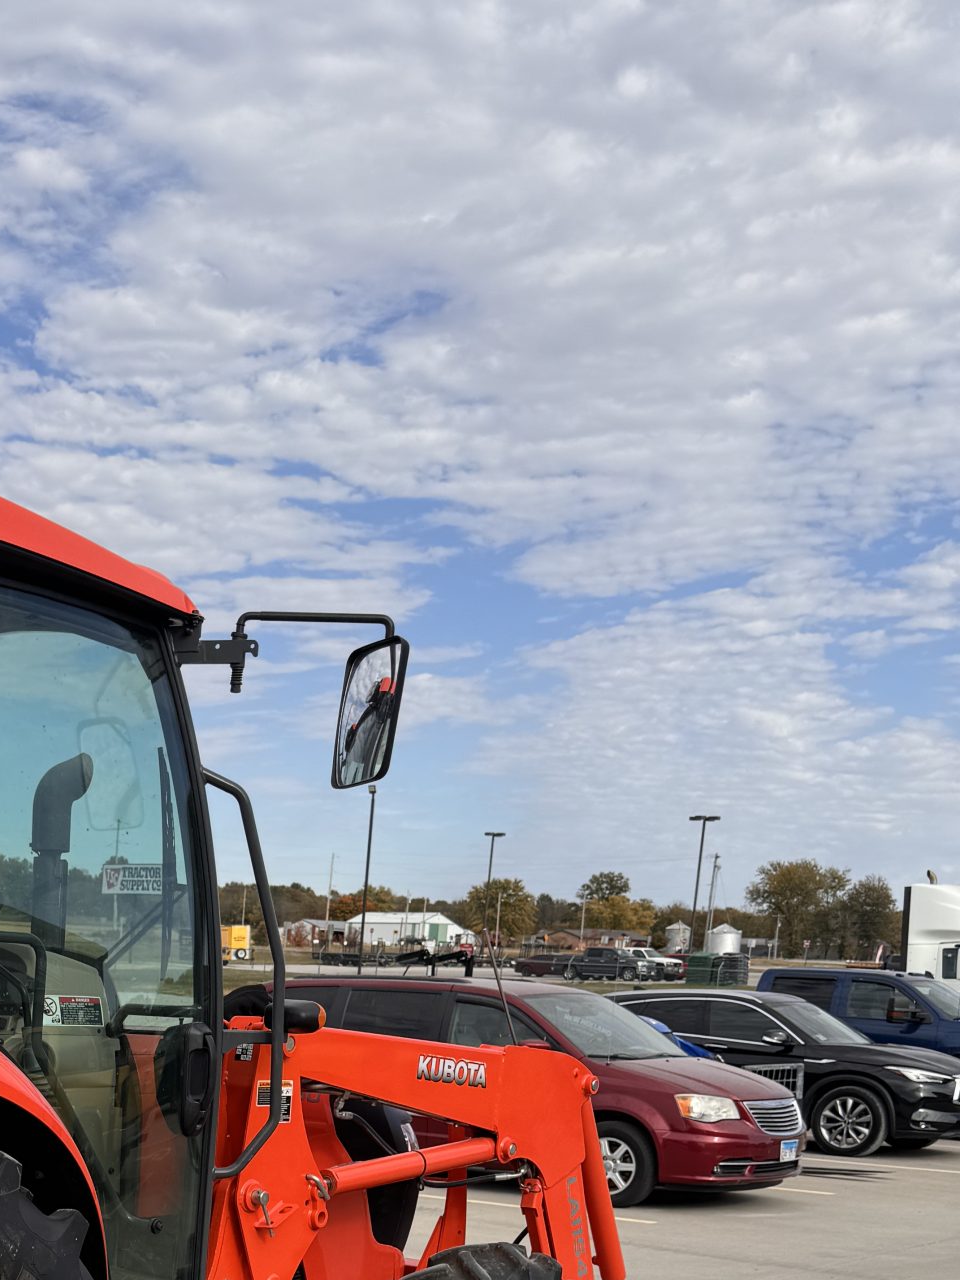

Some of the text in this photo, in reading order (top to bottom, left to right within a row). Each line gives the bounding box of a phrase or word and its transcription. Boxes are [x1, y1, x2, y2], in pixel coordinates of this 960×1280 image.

[121, 867, 161, 879] TRACTOR
[120, 879, 151, 891] SUPPLY
[417, 1054, 487, 1088] KUBOTA
